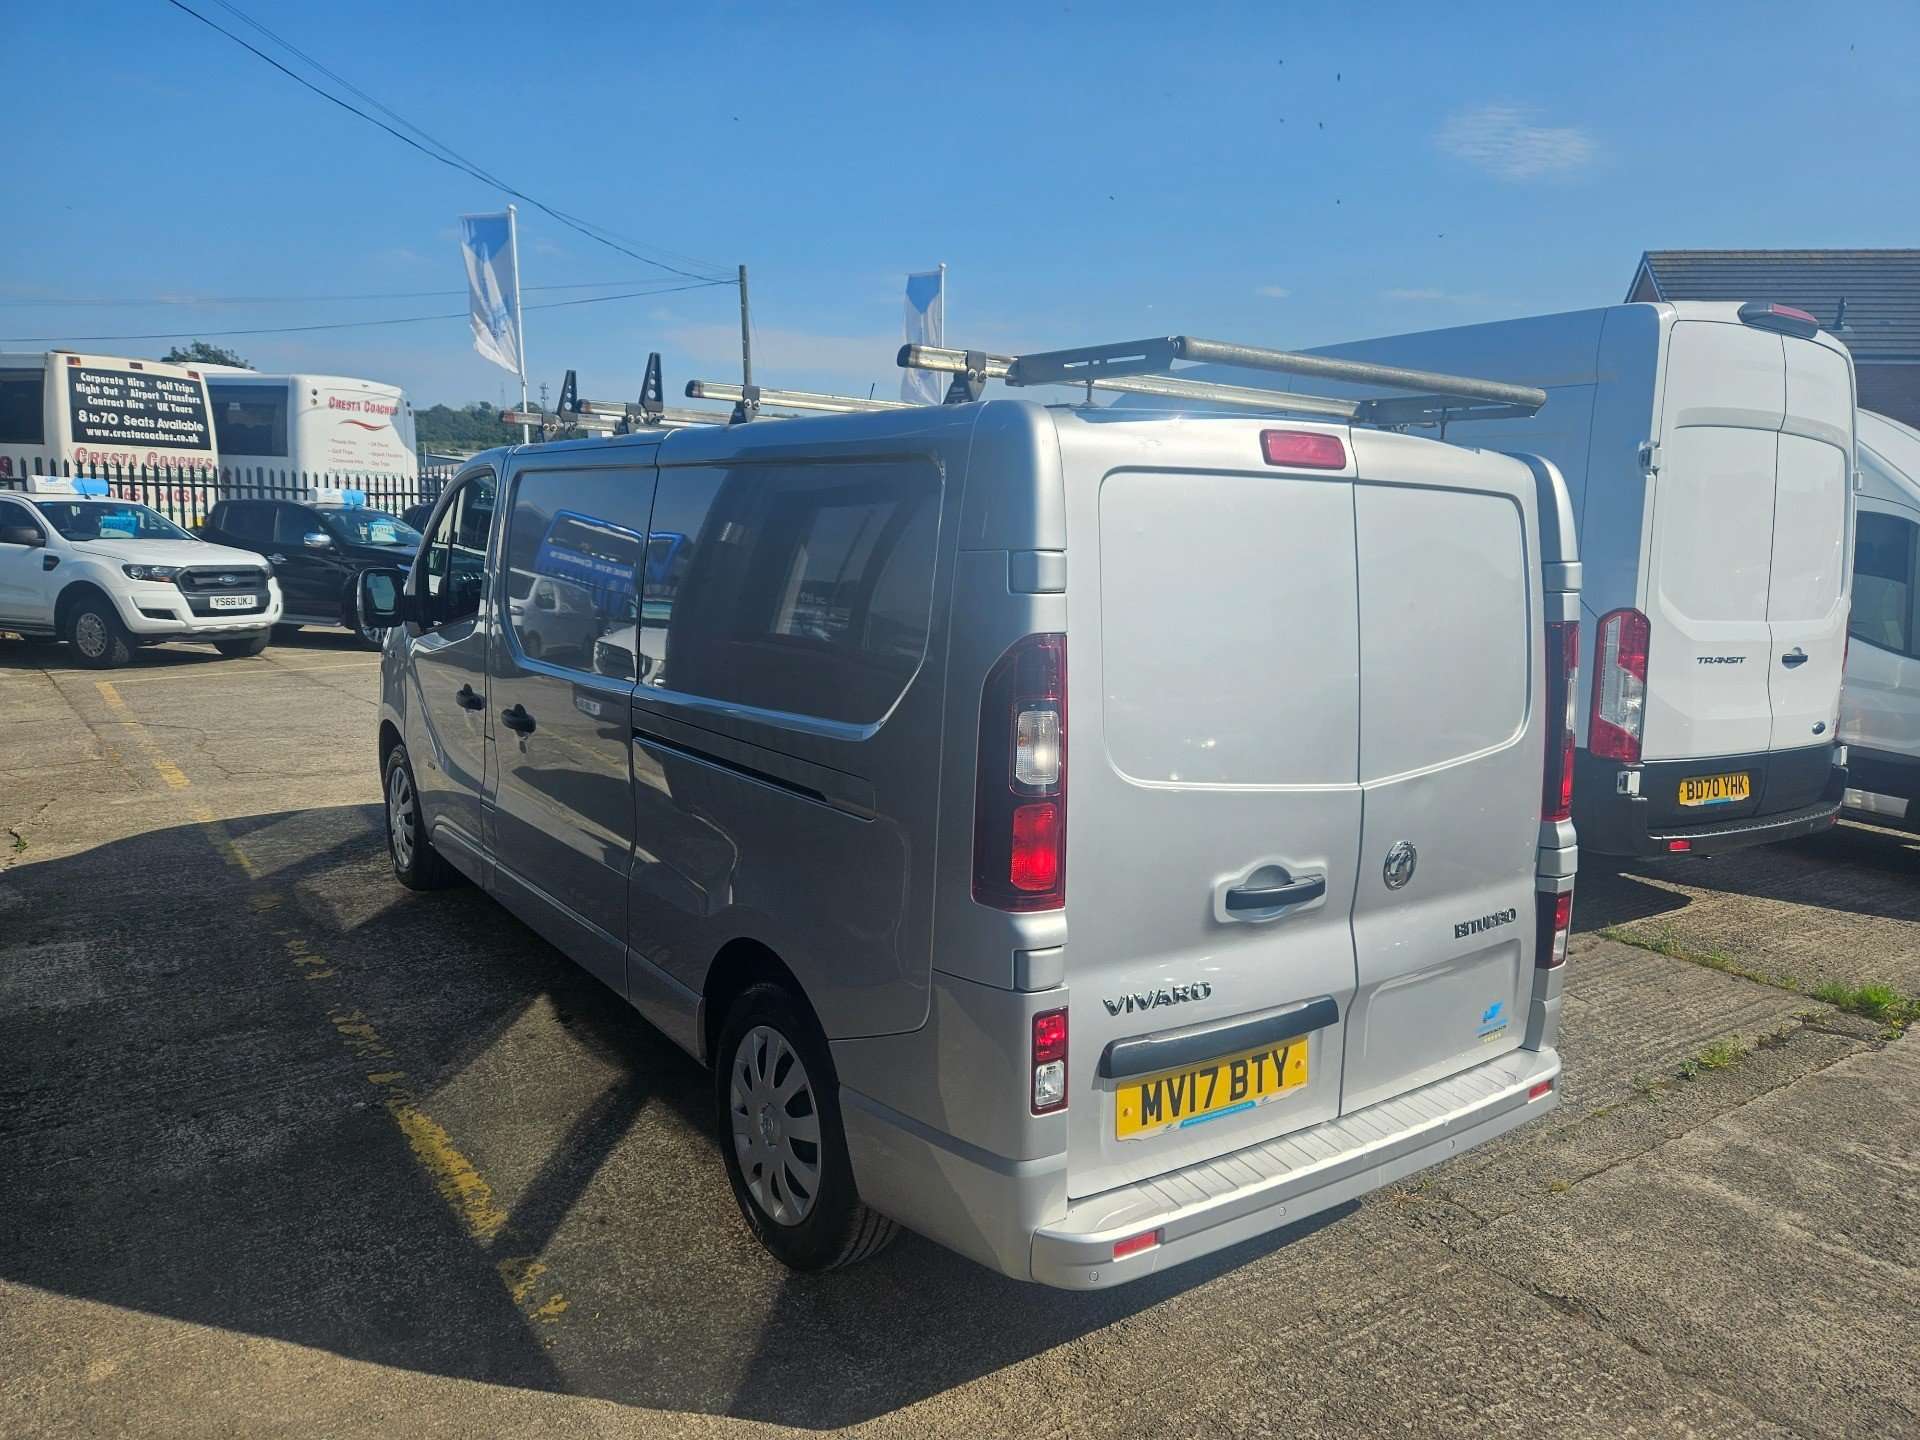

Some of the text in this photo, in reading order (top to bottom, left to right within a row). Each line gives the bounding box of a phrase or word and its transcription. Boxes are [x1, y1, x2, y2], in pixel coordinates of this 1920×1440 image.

[75, 382, 201, 405] Night Out Airport Transfers
[80, 371, 194, 394] Corporate Hire Golf Trips
[87, 395, 193, 414] Contract Hire UK Tours
[78, 409, 204, 432] 8 to 70 Seats Available
[86, 427, 199, 444] www.crestacoaches.co.uk
[214, 597, 236, 606] YS66
[1696, 656, 1747, 665] TRANSIT
[1687, 775, 1745, 800] BD70 YHK
[1454, 907, 1517, 940] BITURBO
[1101, 980, 1212, 1017] VIVARO
[1141, 1065, 1220, 1126] MV17
[1229, 1046, 1289, 1102] BTY
